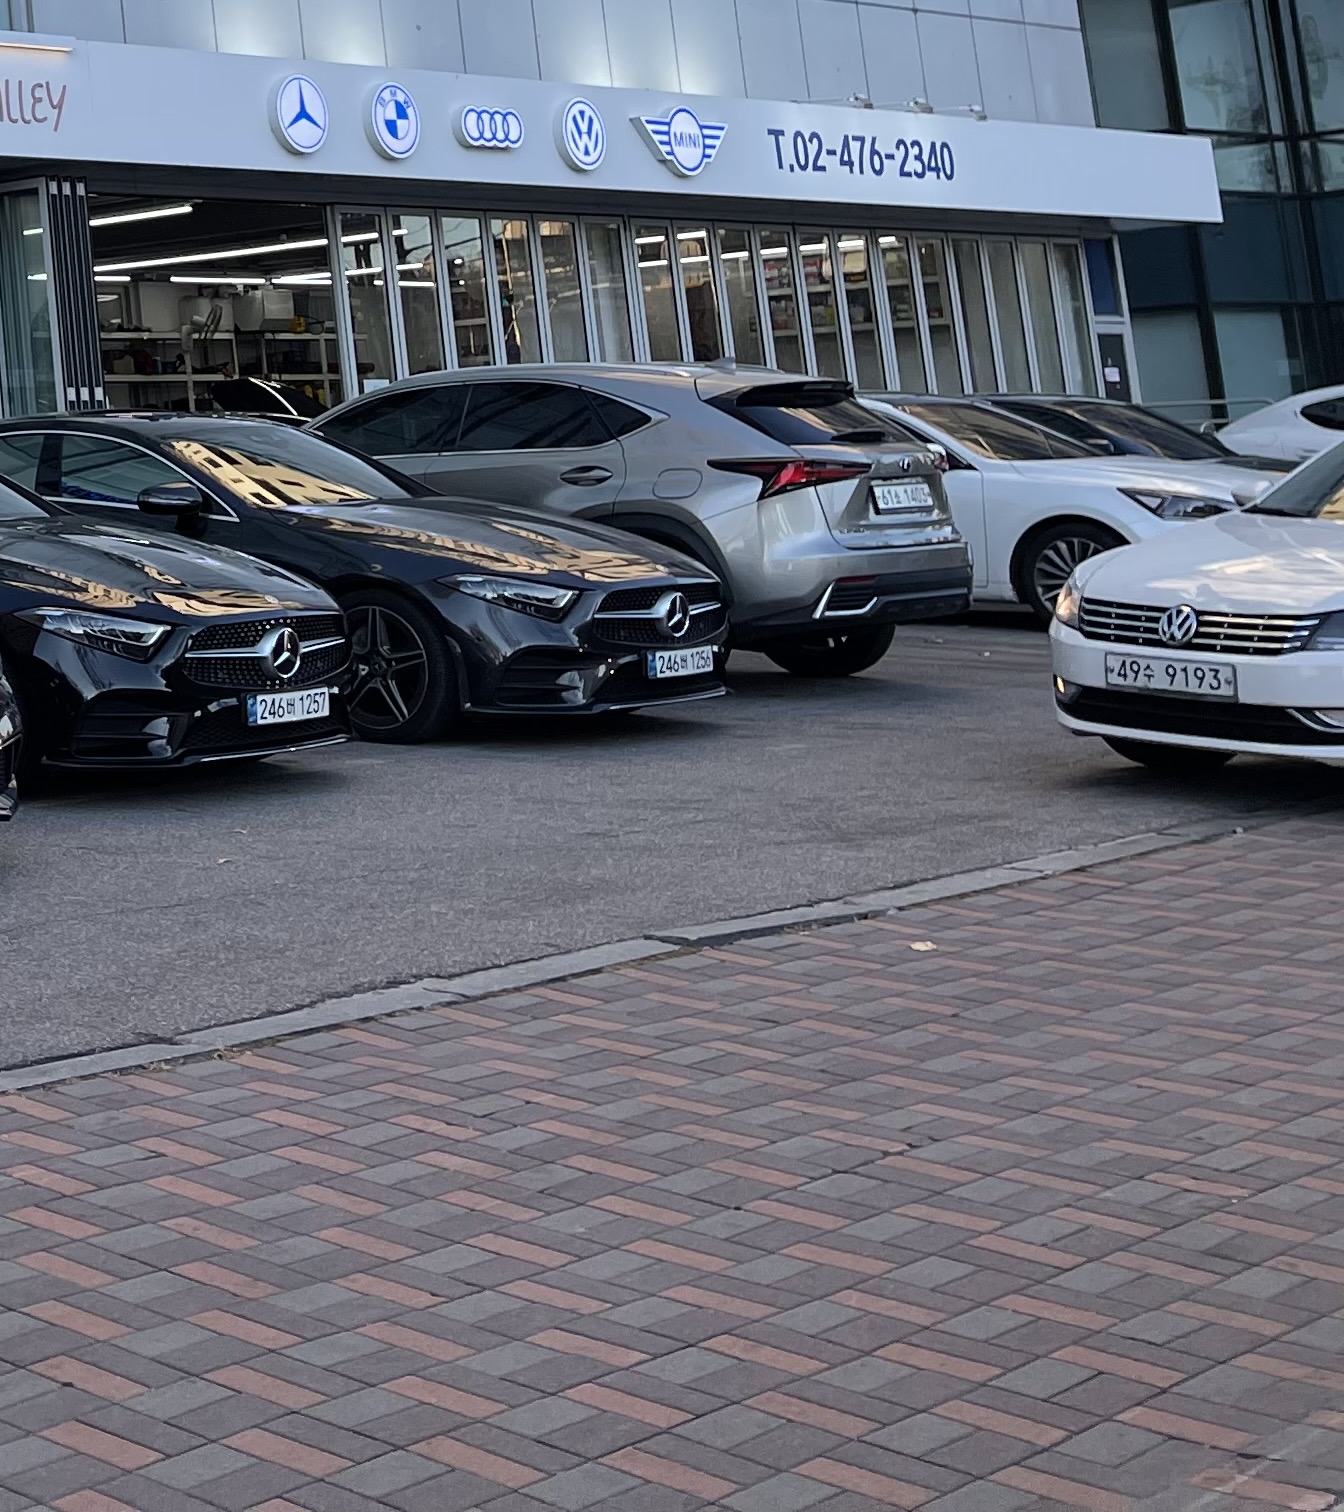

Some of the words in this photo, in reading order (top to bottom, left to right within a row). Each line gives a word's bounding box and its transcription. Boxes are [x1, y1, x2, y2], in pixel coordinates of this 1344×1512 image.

[377, 89, 411, 109] BMW
[673, 131, 701, 149] MINI
[767, 128, 956, 182] T.02-476-2340
[690, 649, 711, 670] 1256
[1117, 659, 1155, 685] 49수
[1165, 663, 1221, 691] 9193
[299, 691, 327, 716] 1257
